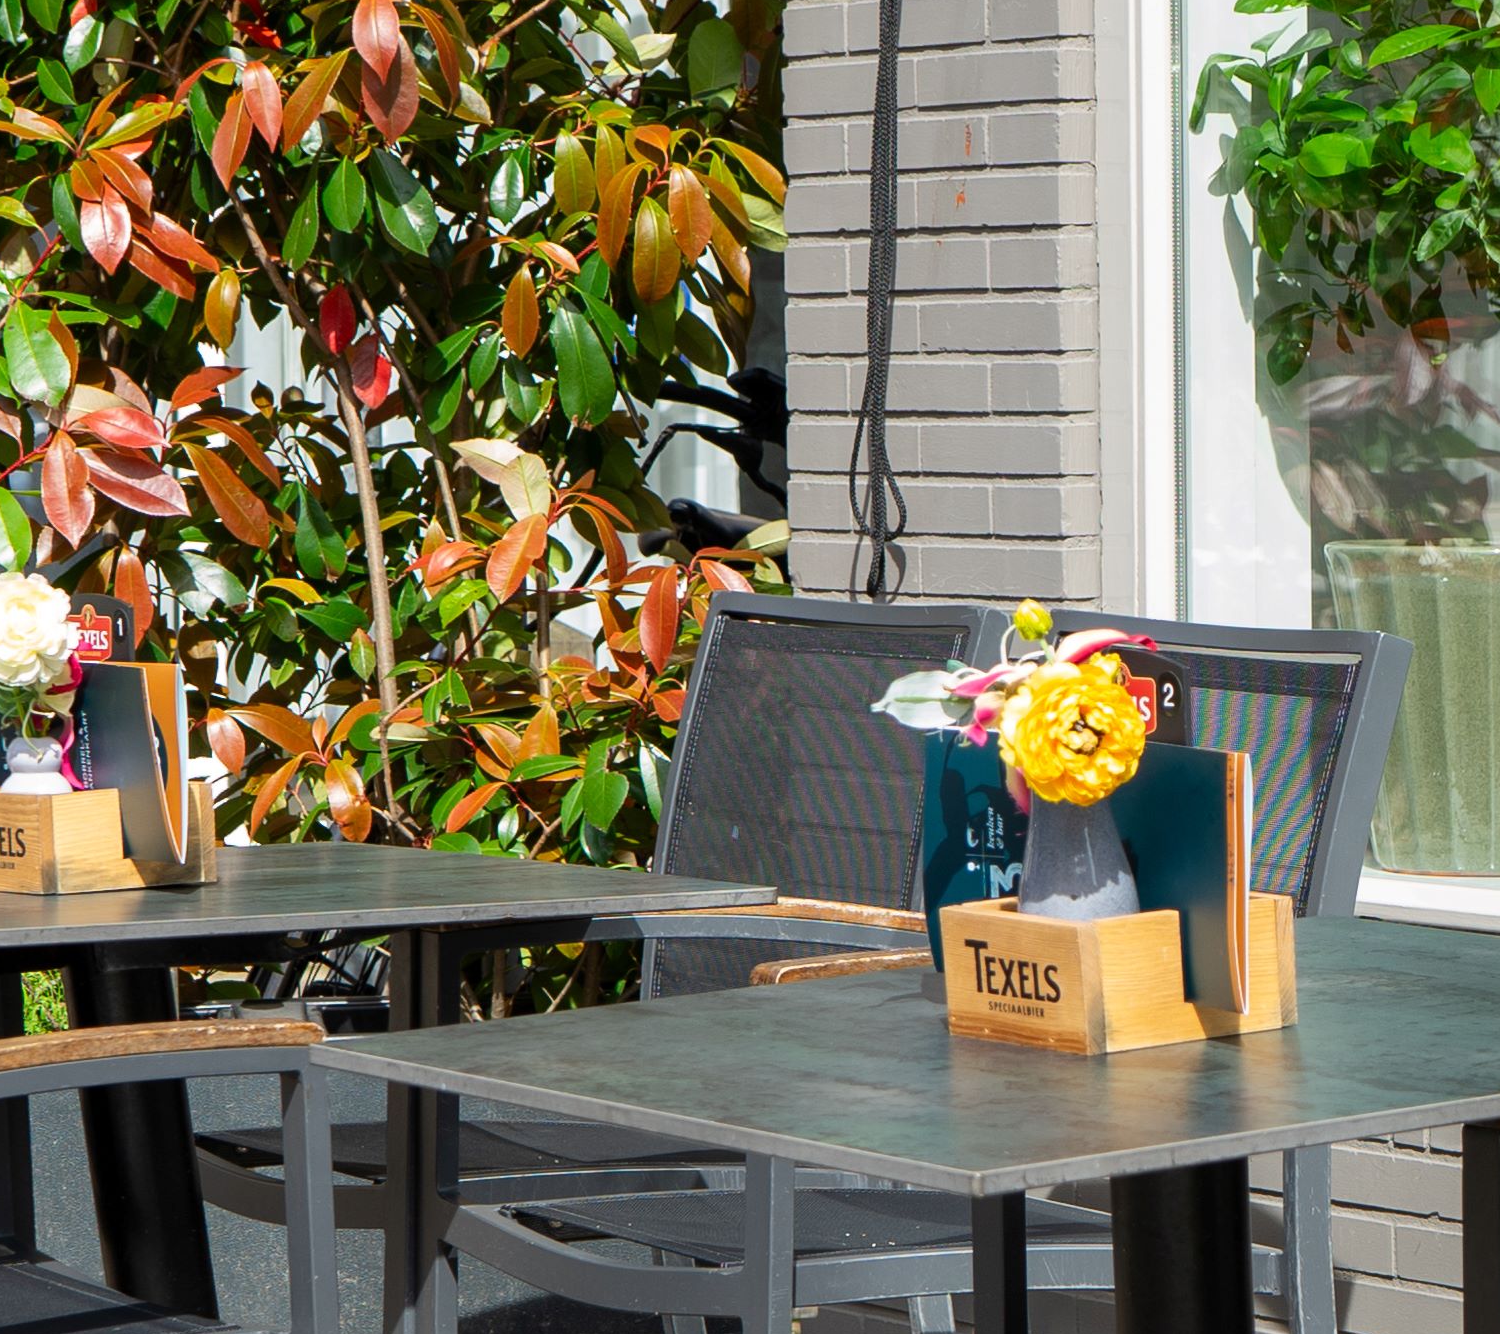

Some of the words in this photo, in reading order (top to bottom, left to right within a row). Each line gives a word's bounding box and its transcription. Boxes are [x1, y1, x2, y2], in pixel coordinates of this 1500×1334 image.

[116, 617, 124, 637] 1
[1163, 682, 1176, 708] 2
[964, 938, 1061, 1004] TEXELS
[988, 1001, 1045, 1018] SPECIAALBIER
